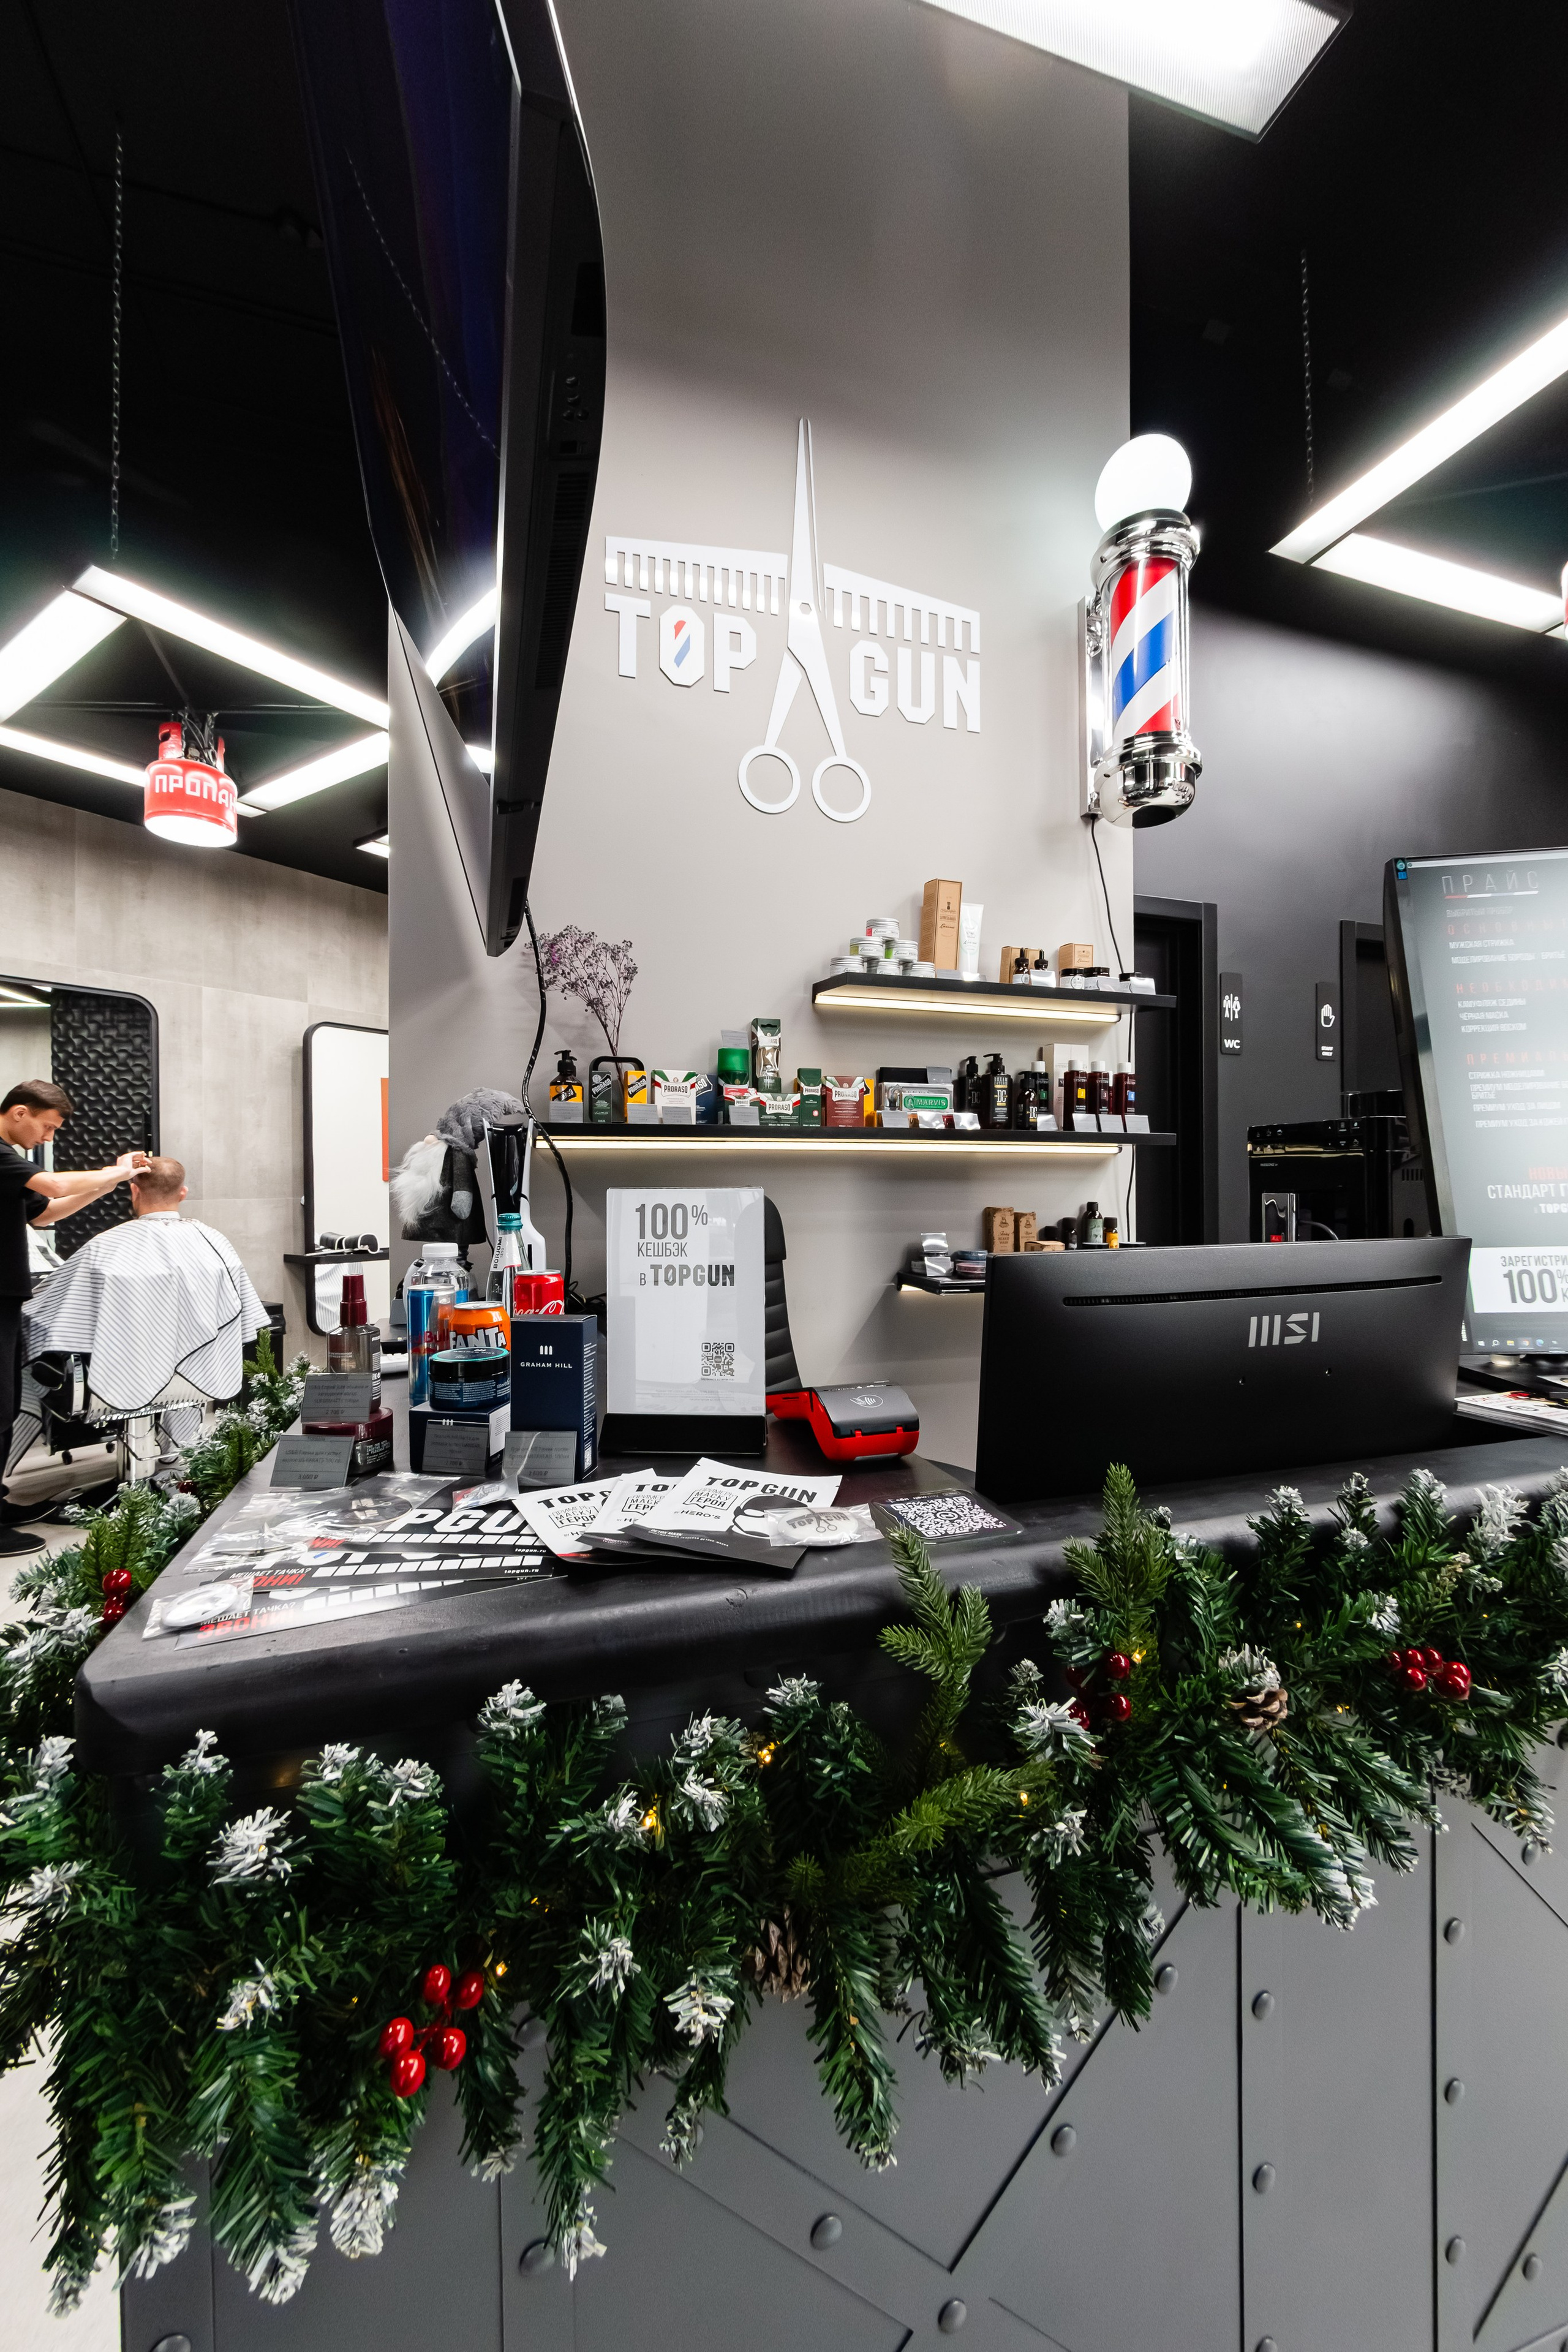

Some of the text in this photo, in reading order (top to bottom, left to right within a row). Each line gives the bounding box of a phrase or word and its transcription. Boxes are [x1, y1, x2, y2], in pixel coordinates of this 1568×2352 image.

[605, 592, 981, 733] TOP GUN
[1442, 870, 1539, 894] ПРАЙС
[1224, 1039, 1240, 1049] WC
[592, 1077, 611, 1095] PRORASO
[628, 1078, 646, 1095] PRORASO
[664, 1085, 688, 1093] PRORASO
[997, 1090, 1006, 1102] DC
[1030, 1106, 1038, 1118] DC
[1487, 1184, 1556, 1199] СТАНДАРТ
[1539, 1203, 1568, 1213] TOPG
[635, 1203, 708, 1240] 100%
[493, 1237, 502, 1269] BORJOMI
[638, 1242, 688, 1257] КЕШБЭК
[650, 1264, 735, 1287] TOPGUN
[450, 1327, 507, 1349] FANTA
[695, 1491, 731, 1501] МАСКУ
[699, 1488, 734, 1498] ПРИМЕРЬ
[706, 1477, 818, 1503] TOPGUN
[690, 1496, 726, 1507] ГЕРОЯ
[552, 1505, 591, 1517] ПРИМЕРЬ
[556, 1509, 592, 1521] МАСКУ
[680, 1510, 721, 1520] HERO'S
[383, 1509, 537, 1534] PGU
[559, 1514, 596, 1525] ГЕРОЯ
[789, 1518, 813, 1529] TOP
[229, 1569, 273, 1579] МЕШАЕТ
[253, 1602, 296, 1617] ТАЧКА?
[197, 1608, 295, 1640] ЗВОНИ!
